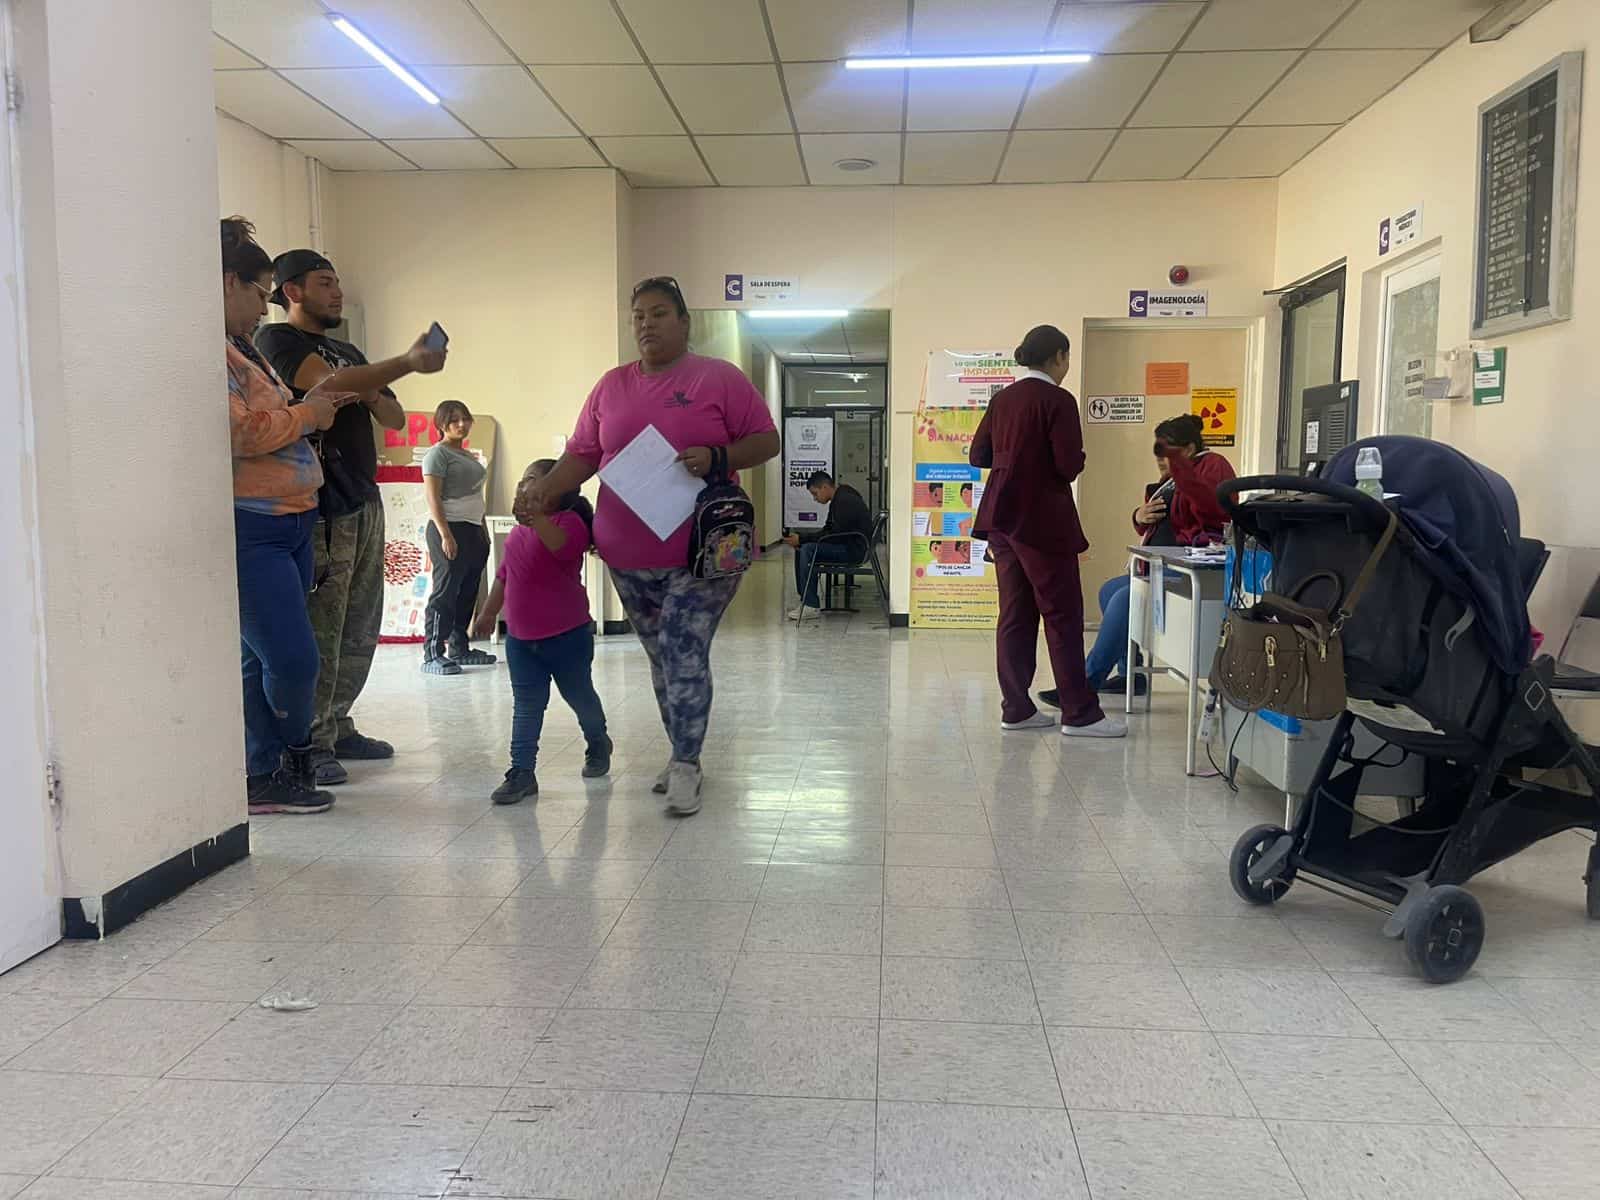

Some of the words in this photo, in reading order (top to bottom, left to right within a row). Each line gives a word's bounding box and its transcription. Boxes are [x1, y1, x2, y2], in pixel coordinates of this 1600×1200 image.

[1149, 295, 1205, 304] IMAGENOLOGÍA
[977, 359, 1018, 367] SIENTES
[963, 367, 1010, 376] IMPORTA
